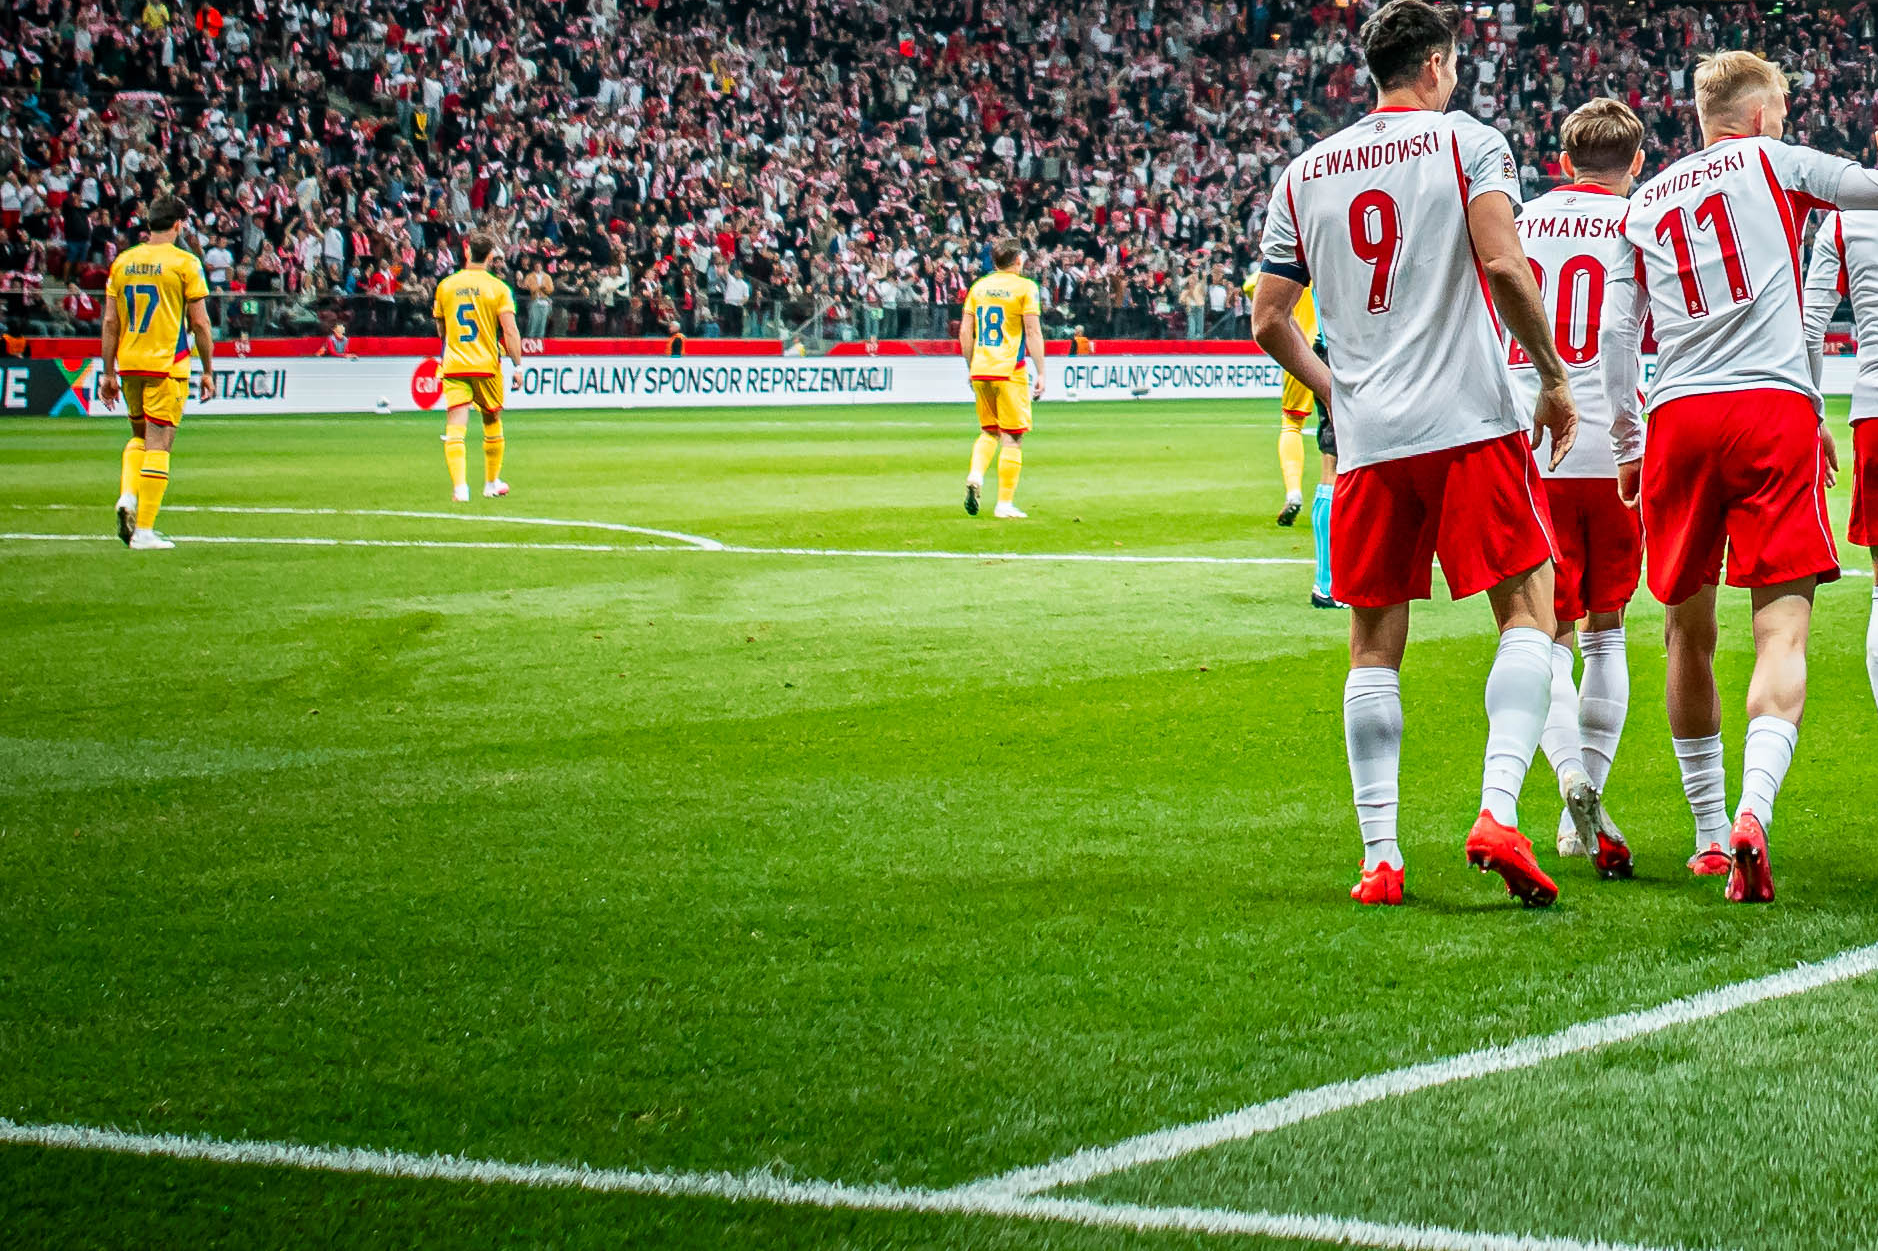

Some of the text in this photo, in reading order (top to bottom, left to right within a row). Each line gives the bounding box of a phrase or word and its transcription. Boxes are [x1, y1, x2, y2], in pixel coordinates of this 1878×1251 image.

[1302, 131, 1439, 182] LEWANDOWSKI
[1348, 189, 1403, 315] 9
[1655, 191, 1754, 319] 11
[124, 284, 160, 334] 17
[456, 304, 479, 342] 5
[976, 306, 1005, 347] 18
[524, 366, 894, 395] OFICJALNY SPONSOR REPREZENTACJI
[1063, 365, 1150, 389] OFICJALNY
[1151, 364, 1224, 389] SPONSOR
